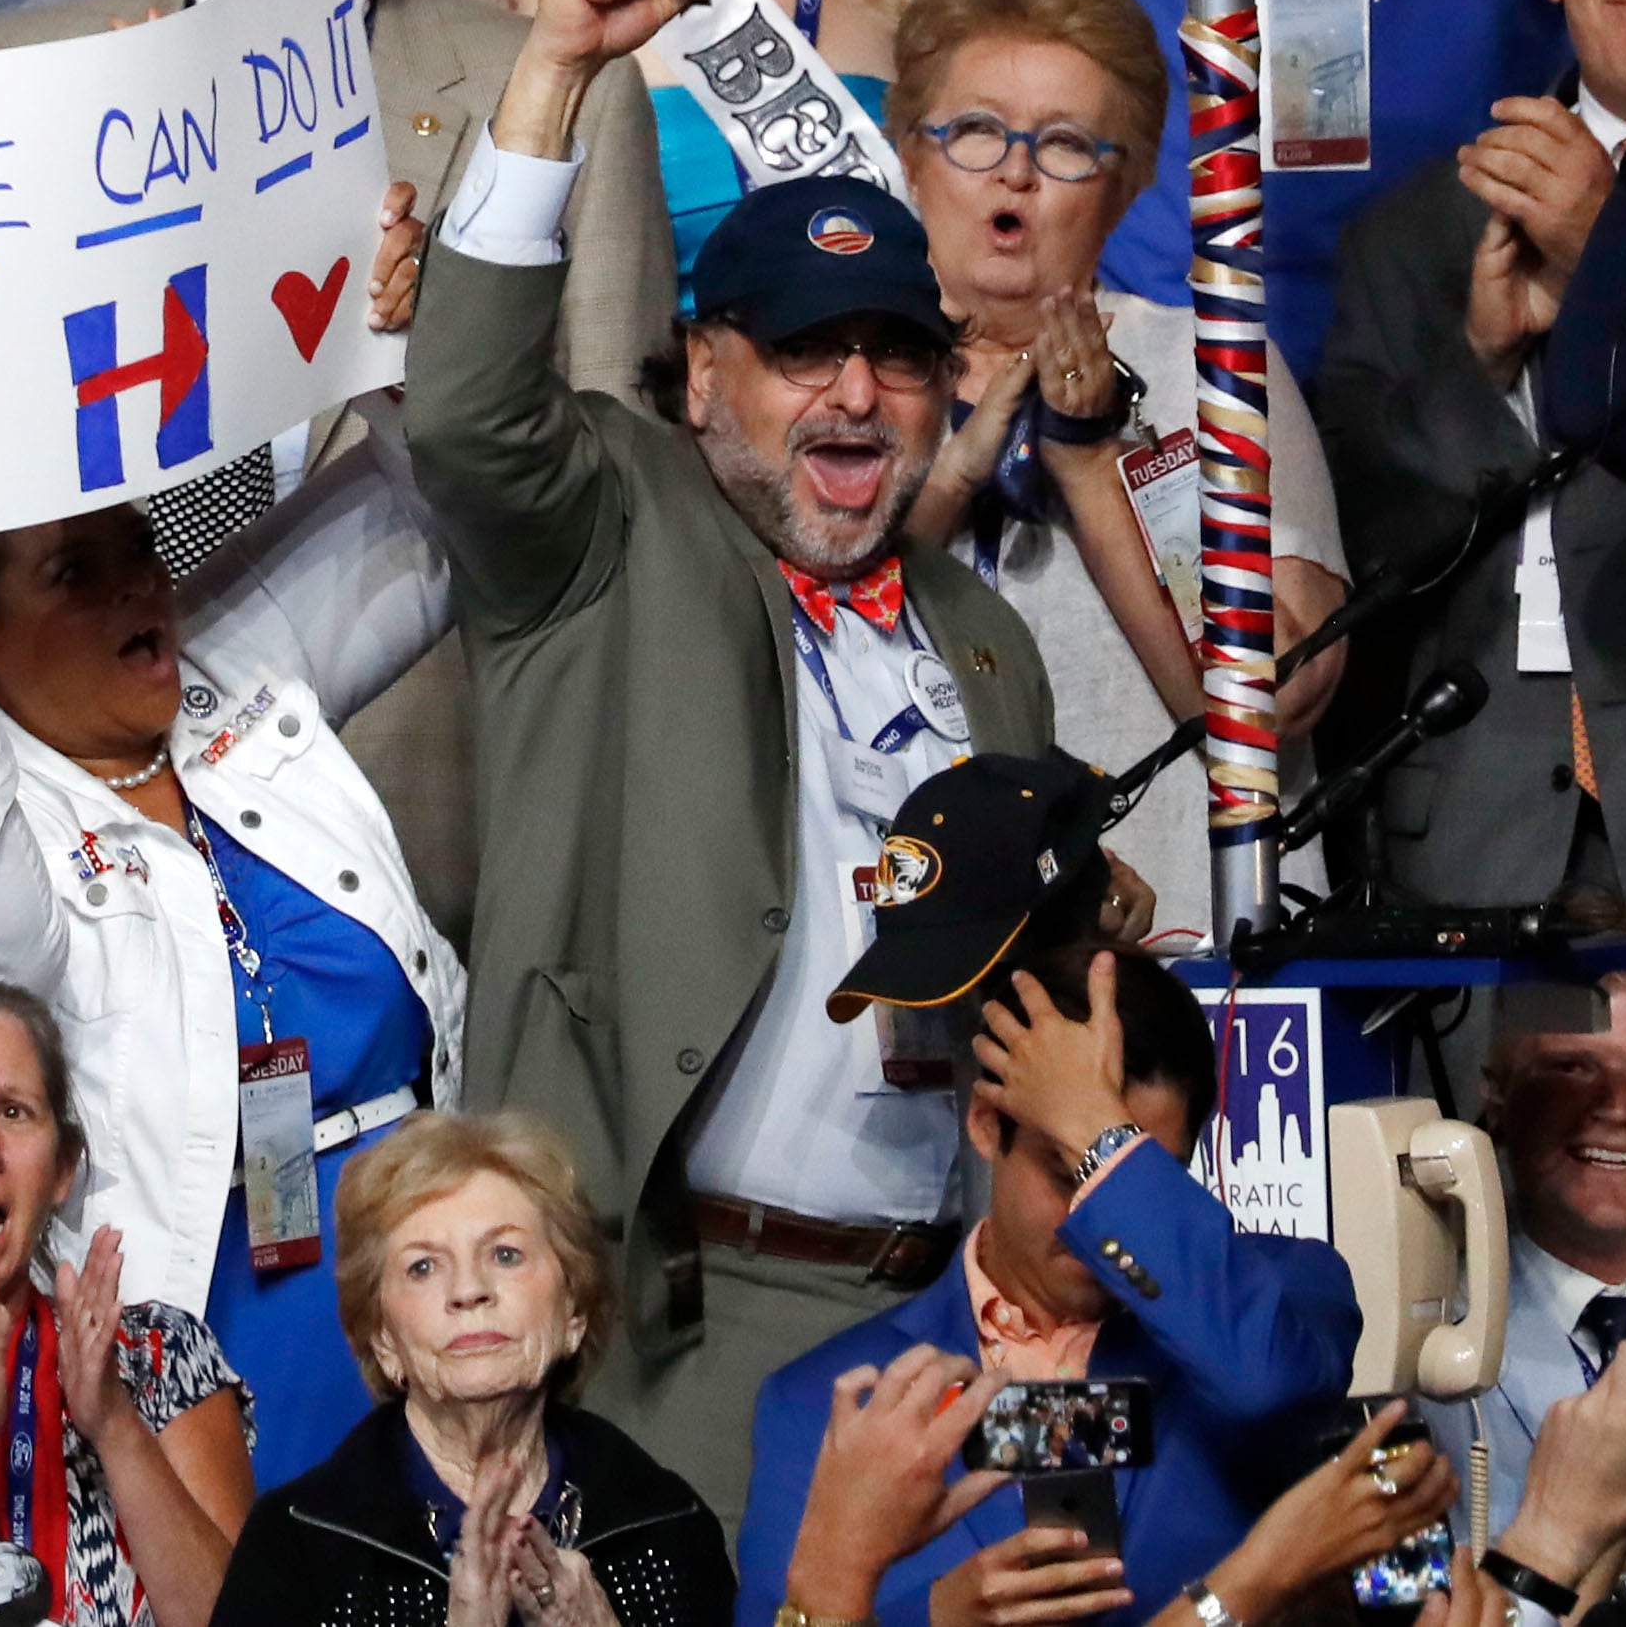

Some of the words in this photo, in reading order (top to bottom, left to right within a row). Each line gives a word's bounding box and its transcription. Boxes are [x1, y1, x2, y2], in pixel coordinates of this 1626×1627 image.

[94, 77, 219, 204] CAN
[241, 37, 317, 144] DO
[1130, 443, 1197, 487] TUESDAY
[793, 625, 814, 655] DNC
[925, 680, 956, 699] SHOW
[877, 729, 901, 752] DNC
[14, 1495, 26, 1519] DNC
